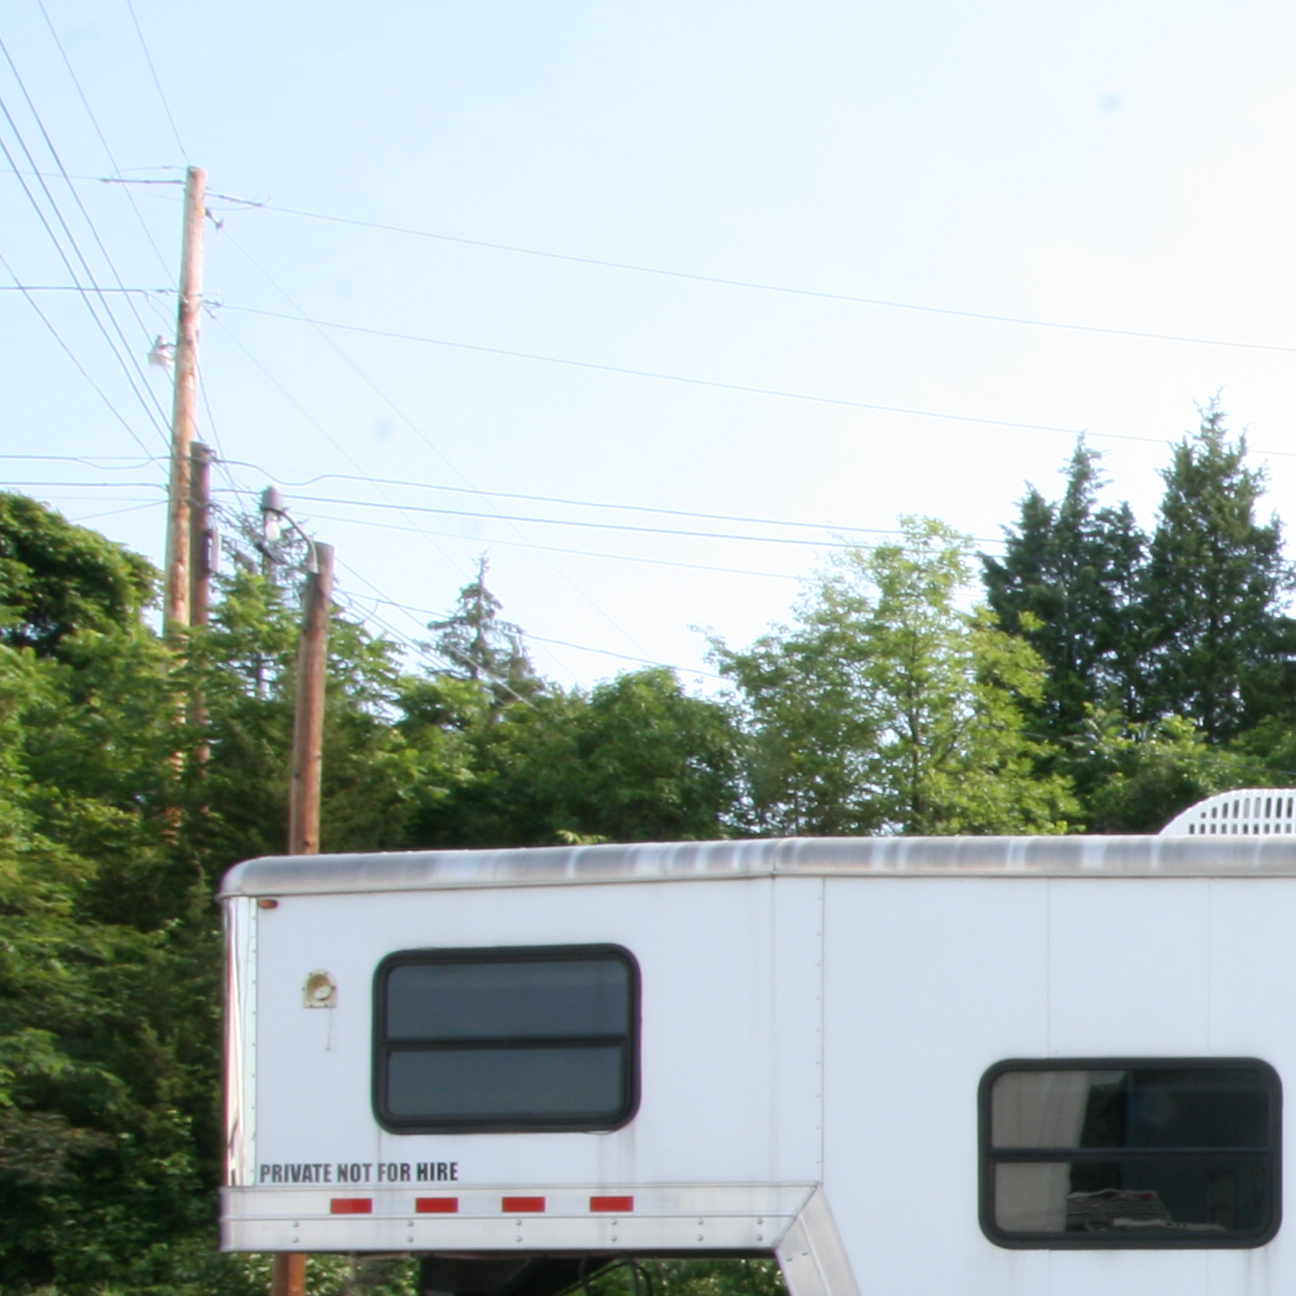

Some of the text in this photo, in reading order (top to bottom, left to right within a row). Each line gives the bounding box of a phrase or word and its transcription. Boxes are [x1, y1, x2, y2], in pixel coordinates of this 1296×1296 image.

[260, 1162, 458, 1183] PRIVATE NOT FOR HIRE
